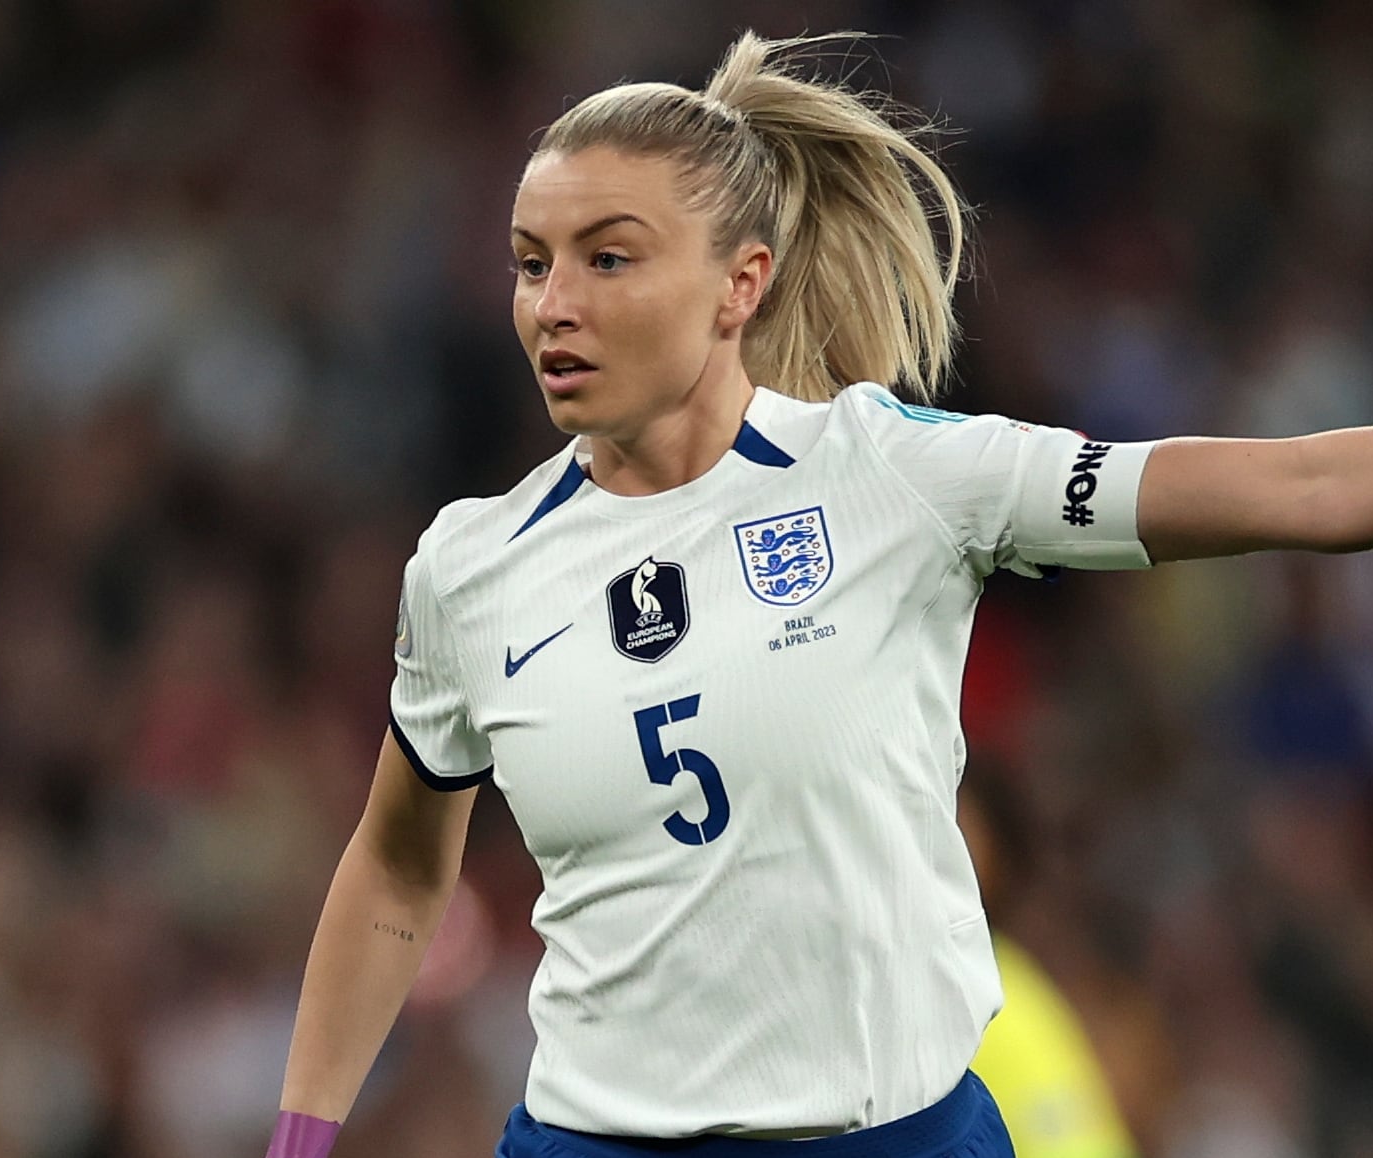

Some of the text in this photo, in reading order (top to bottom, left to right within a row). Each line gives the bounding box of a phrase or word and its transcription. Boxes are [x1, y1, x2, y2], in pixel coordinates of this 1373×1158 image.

[627, 621, 674, 641] EUROPEAN
[784, 616, 815, 632] BRAZIL
[626, 629, 677, 650] CHAMPIONS
[768, 624, 836, 651] 06 APRIL 2023
[633, 693, 730, 846] 5
